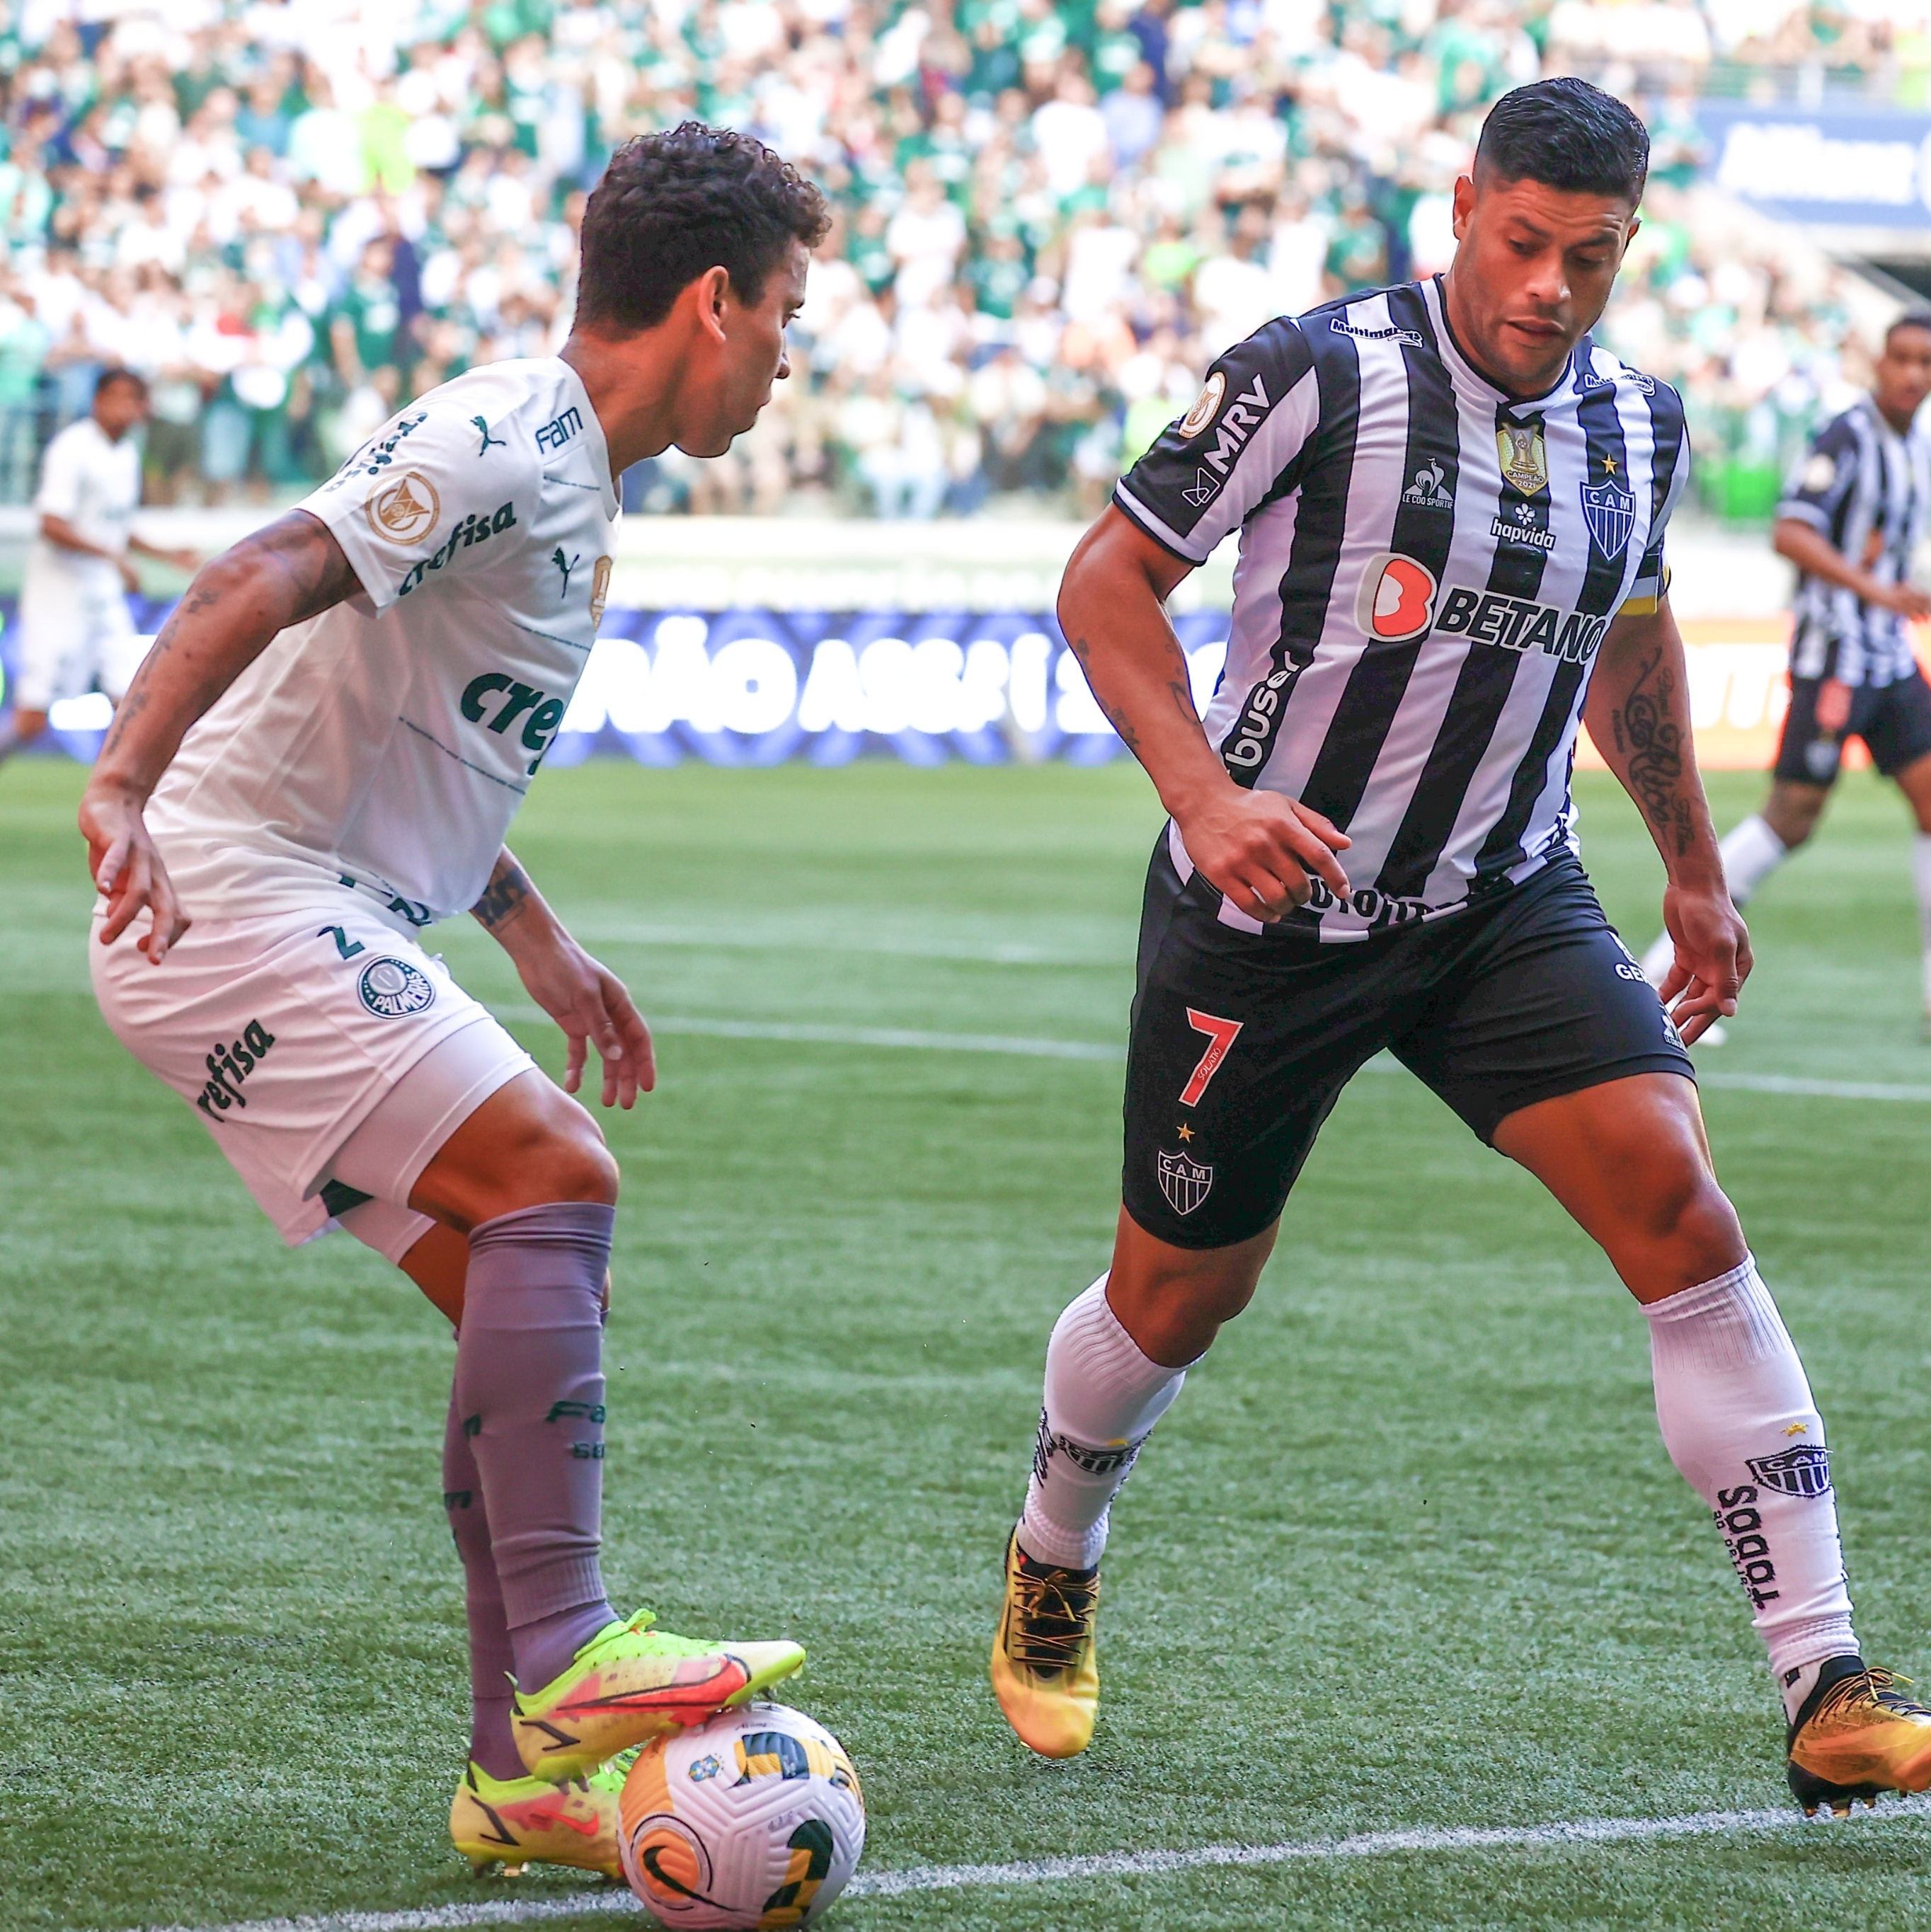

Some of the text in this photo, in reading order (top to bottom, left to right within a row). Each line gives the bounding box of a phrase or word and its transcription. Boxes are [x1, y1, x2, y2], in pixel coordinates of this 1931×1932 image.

[1203, 373, 1270, 476] MRV
[1402, 494, 1411, 502] LE
[1518, 481, 1537, 490] 2021
[1491, 517, 1557, 548] hapvida
[1434, 587, 1606, 663] BETANO
[1225, 650, 1301, 768] buser
[316, 926, 366, 960] 2
[1179, 1006, 1244, 1108] 7
[1163, 1158, 1205, 1180] CAM
[1717, 1485, 1780, 1610] TODOS
